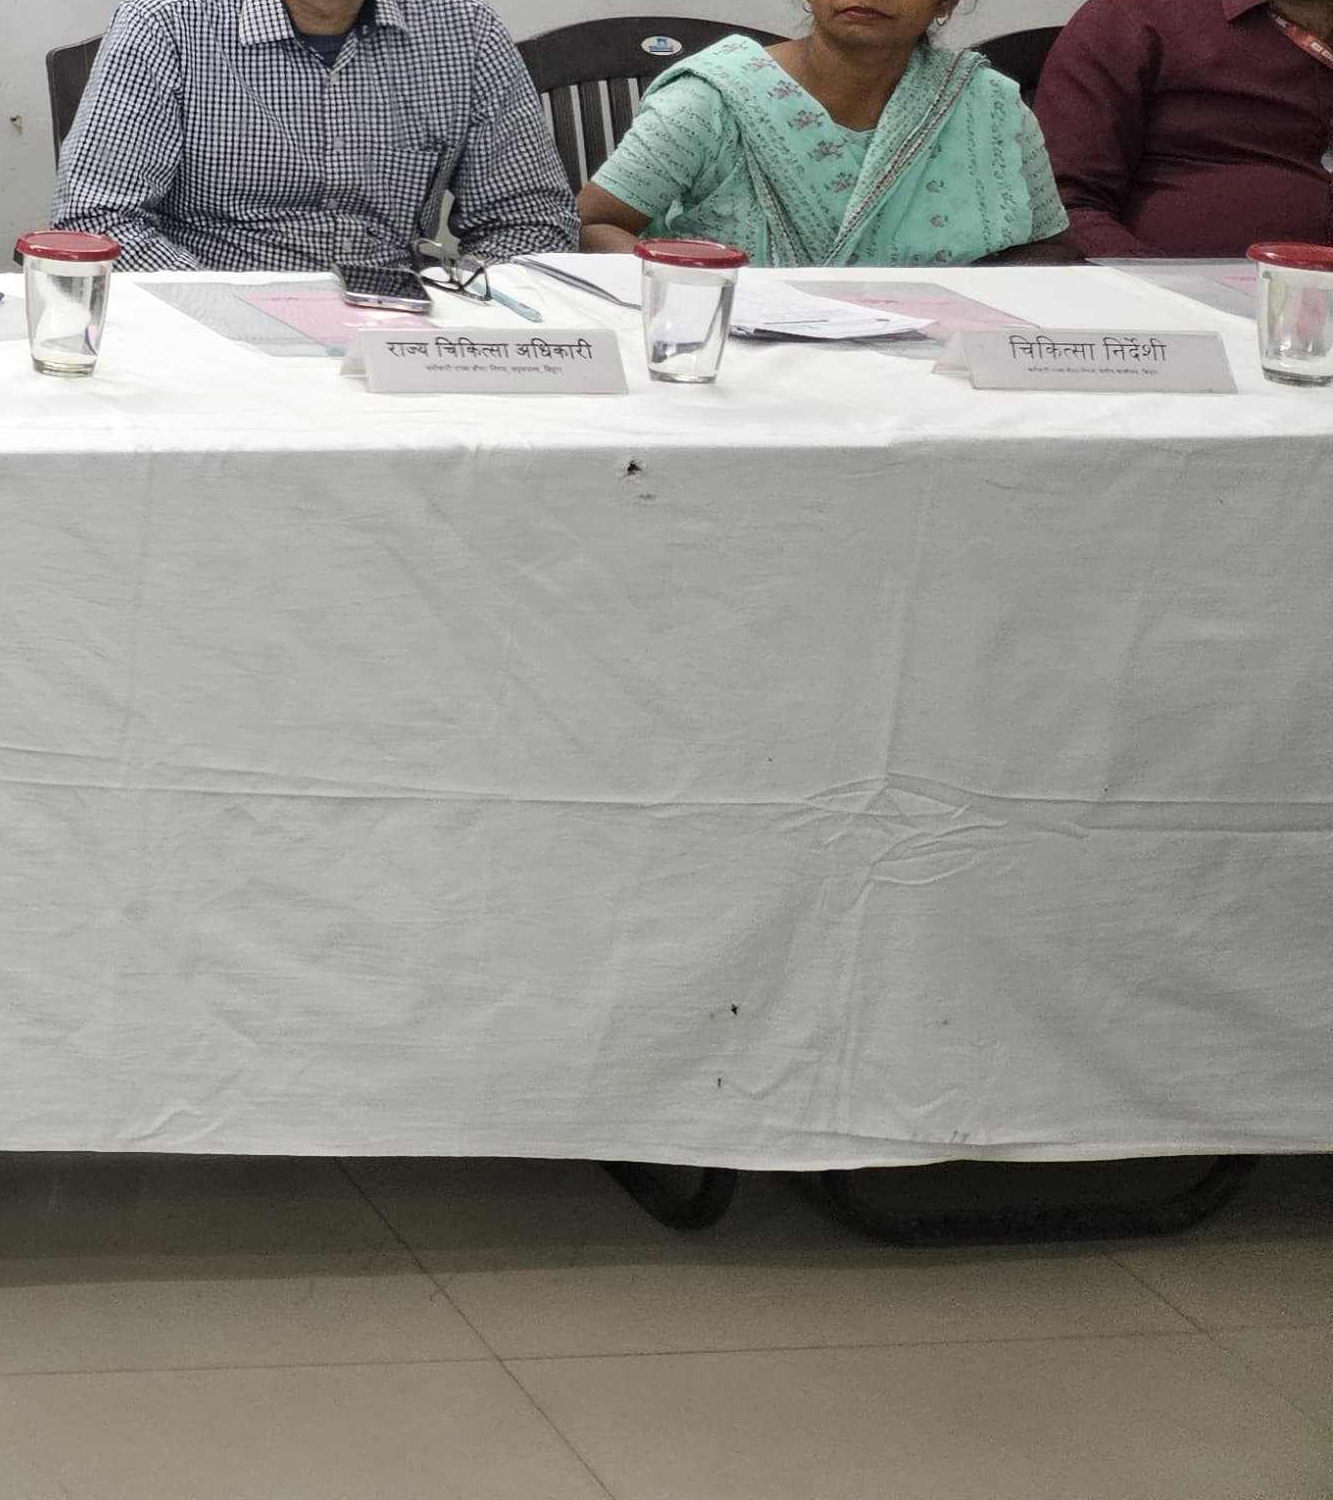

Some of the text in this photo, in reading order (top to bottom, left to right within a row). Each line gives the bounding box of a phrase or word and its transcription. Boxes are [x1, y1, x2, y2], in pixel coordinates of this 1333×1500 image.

[385, 337, 593, 361] राज्य चिकित्सा अधिकारी
[1008, 335, 1096, 362] चिकित्सा
